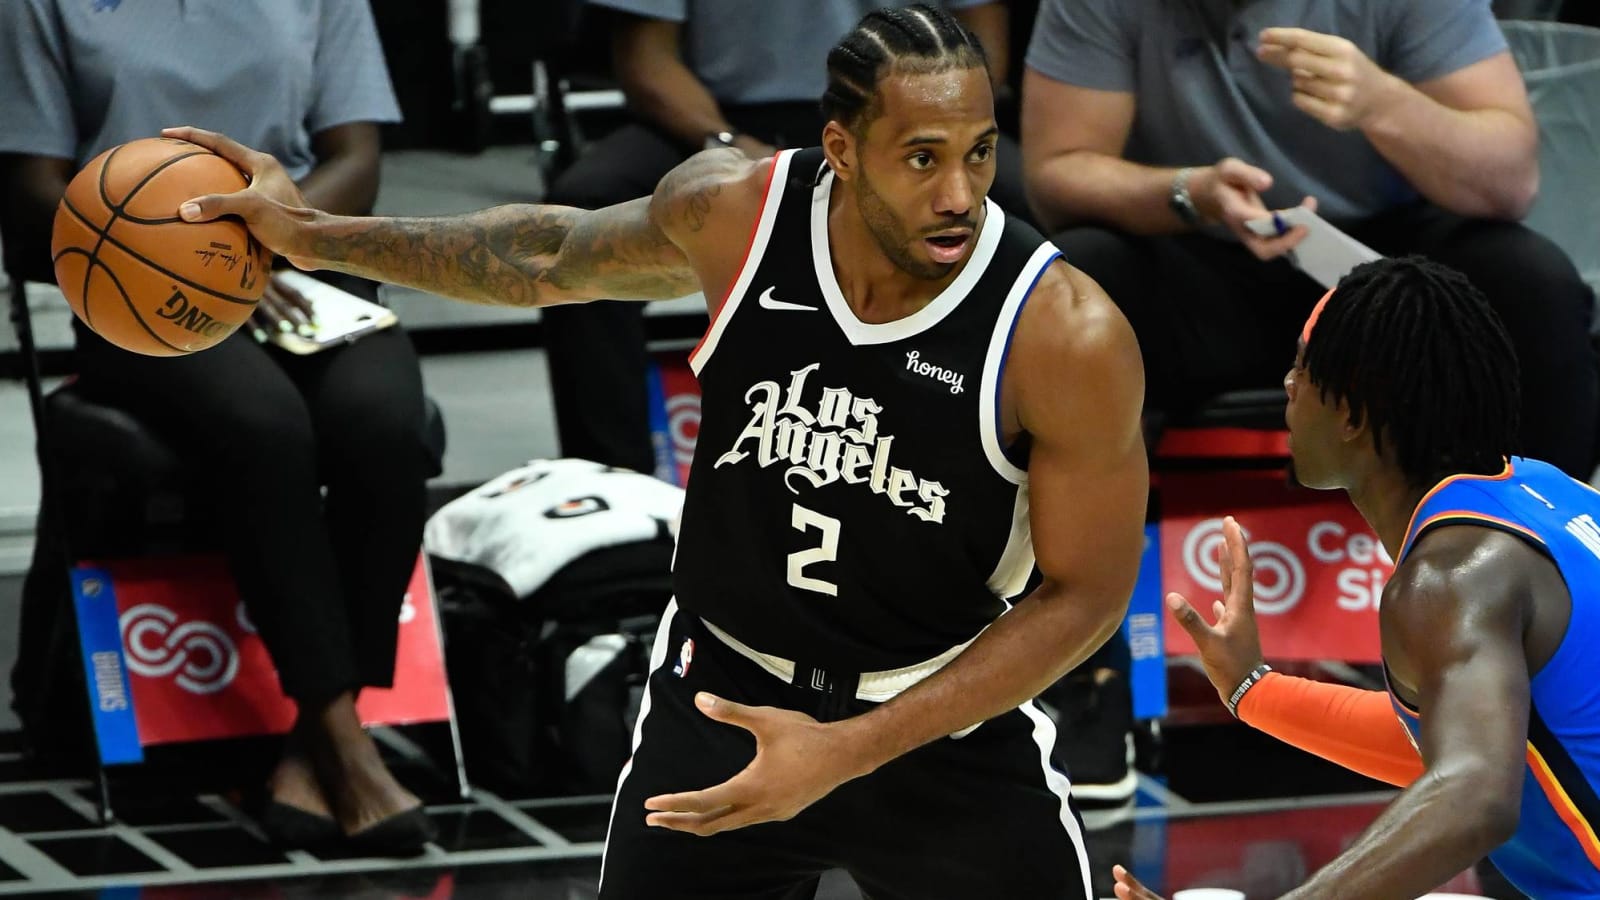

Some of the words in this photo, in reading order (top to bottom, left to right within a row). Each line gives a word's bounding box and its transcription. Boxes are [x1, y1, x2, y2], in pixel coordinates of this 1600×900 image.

[776, 362, 883, 446] Los
[906, 350, 965, 395] honey
[713, 380, 950, 524] Angeles
[787, 503, 841, 597] 2
